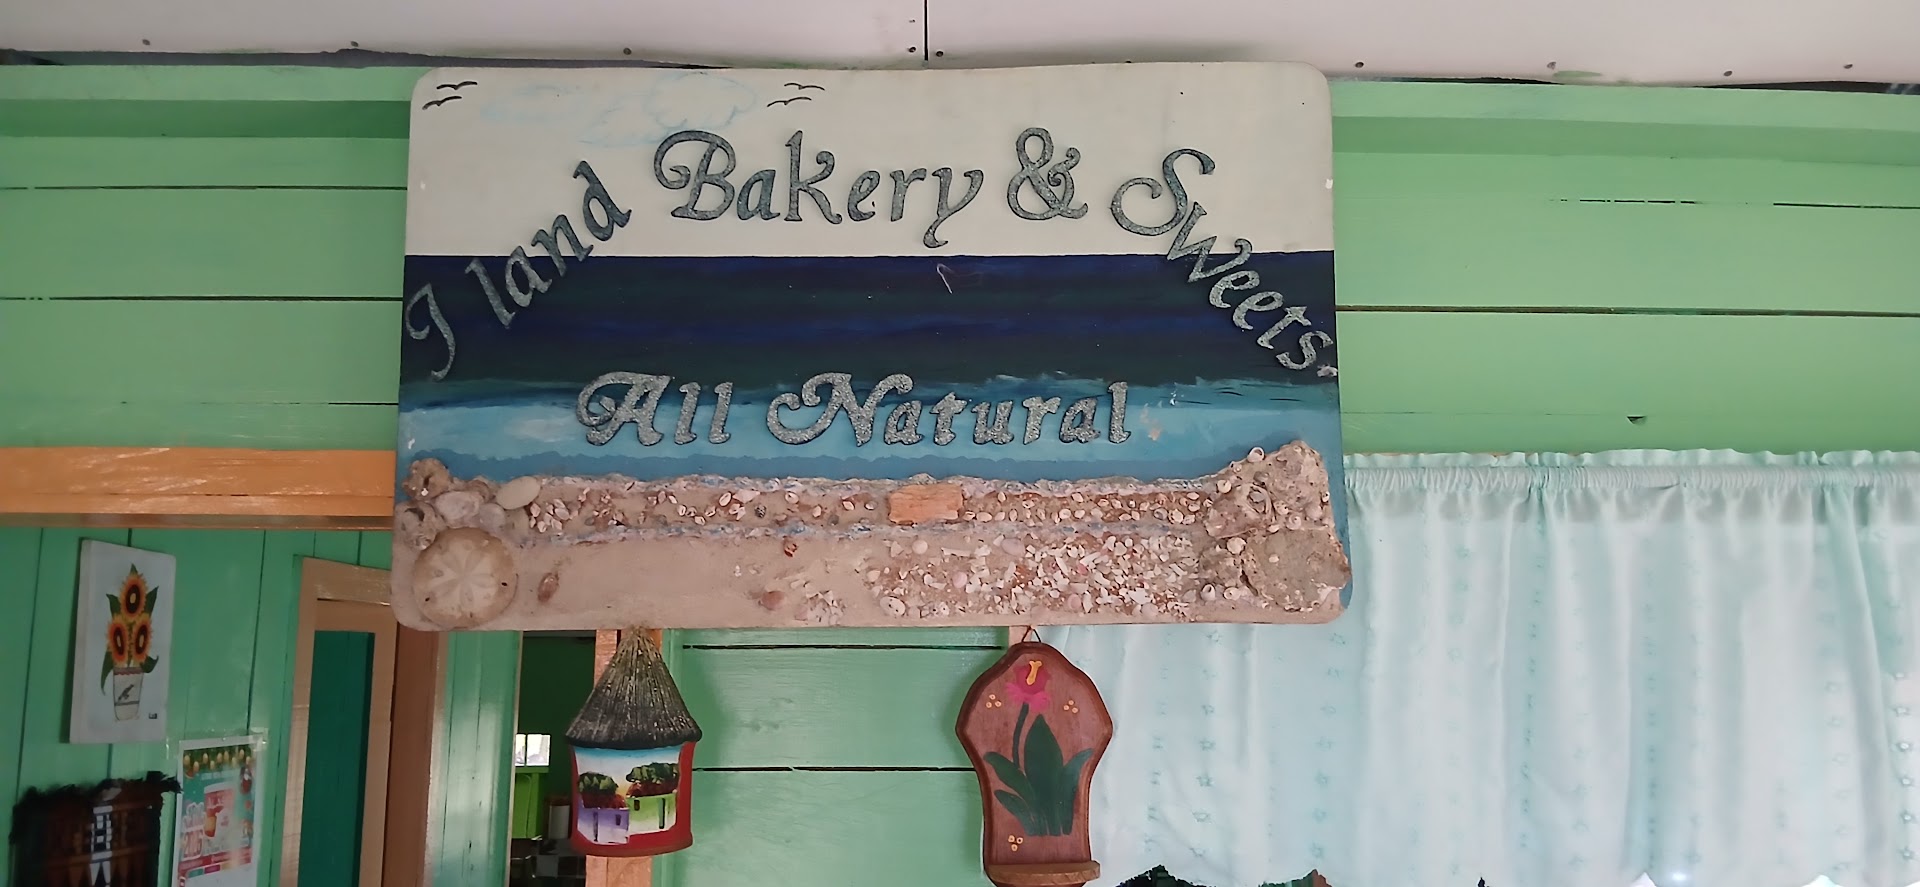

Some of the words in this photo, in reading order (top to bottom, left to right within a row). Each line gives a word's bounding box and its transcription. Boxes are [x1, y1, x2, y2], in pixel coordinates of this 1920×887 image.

[653, 130, 984, 248] Bakery
[1006, 127, 1089, 221] &
[1110, 148, 1334, 371] Sweets
[575, 371, 733, 447] All
[766, 372, 1132, 447] Natural
